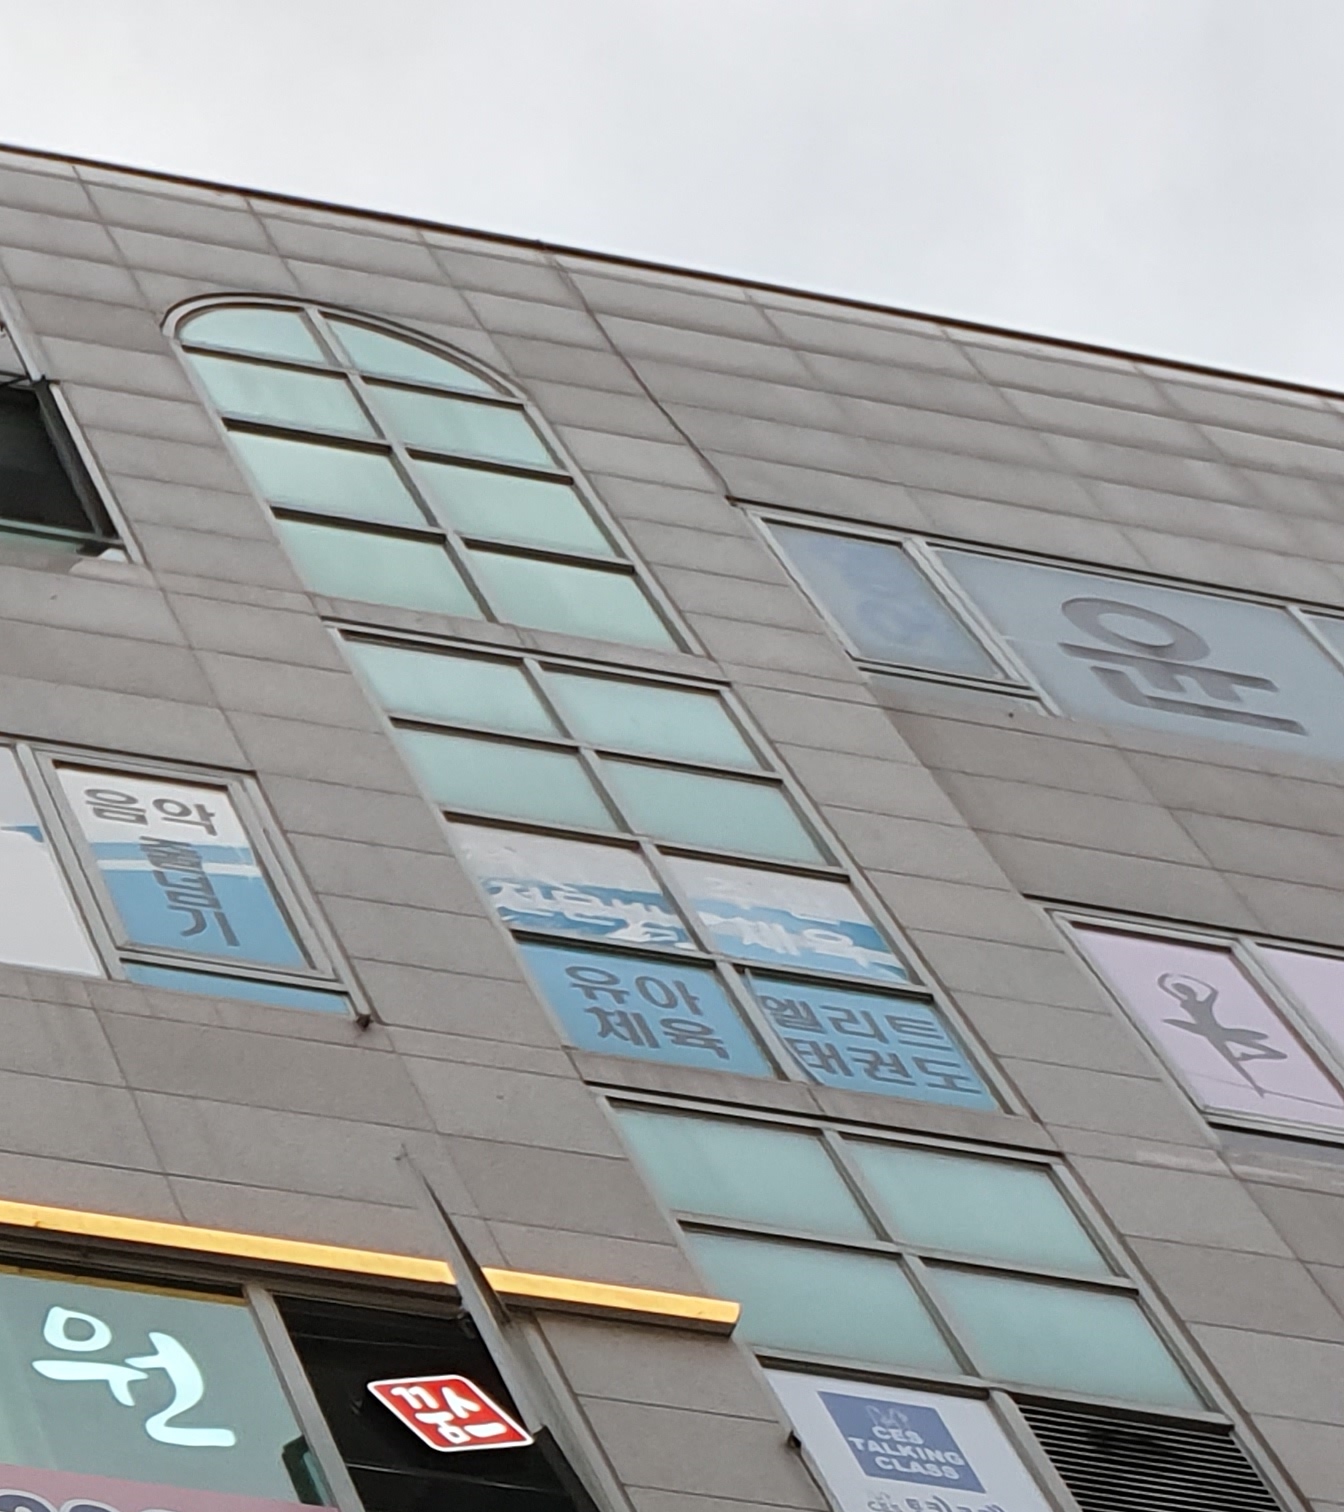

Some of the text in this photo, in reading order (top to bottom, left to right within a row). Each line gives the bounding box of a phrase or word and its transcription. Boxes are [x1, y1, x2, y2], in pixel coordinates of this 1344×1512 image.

[84, 788, 218, 837] 음악
[564, 963, 703, 1016] 유아
[583, 1005, 732, 1061] 체육
[784, 1036, 984, 1096] 태권도
[847, 1436, 966, 1466] TALKING
[871, 1426, 925, 1445] CES
[874, 1456, 961, 1480] CLASS
